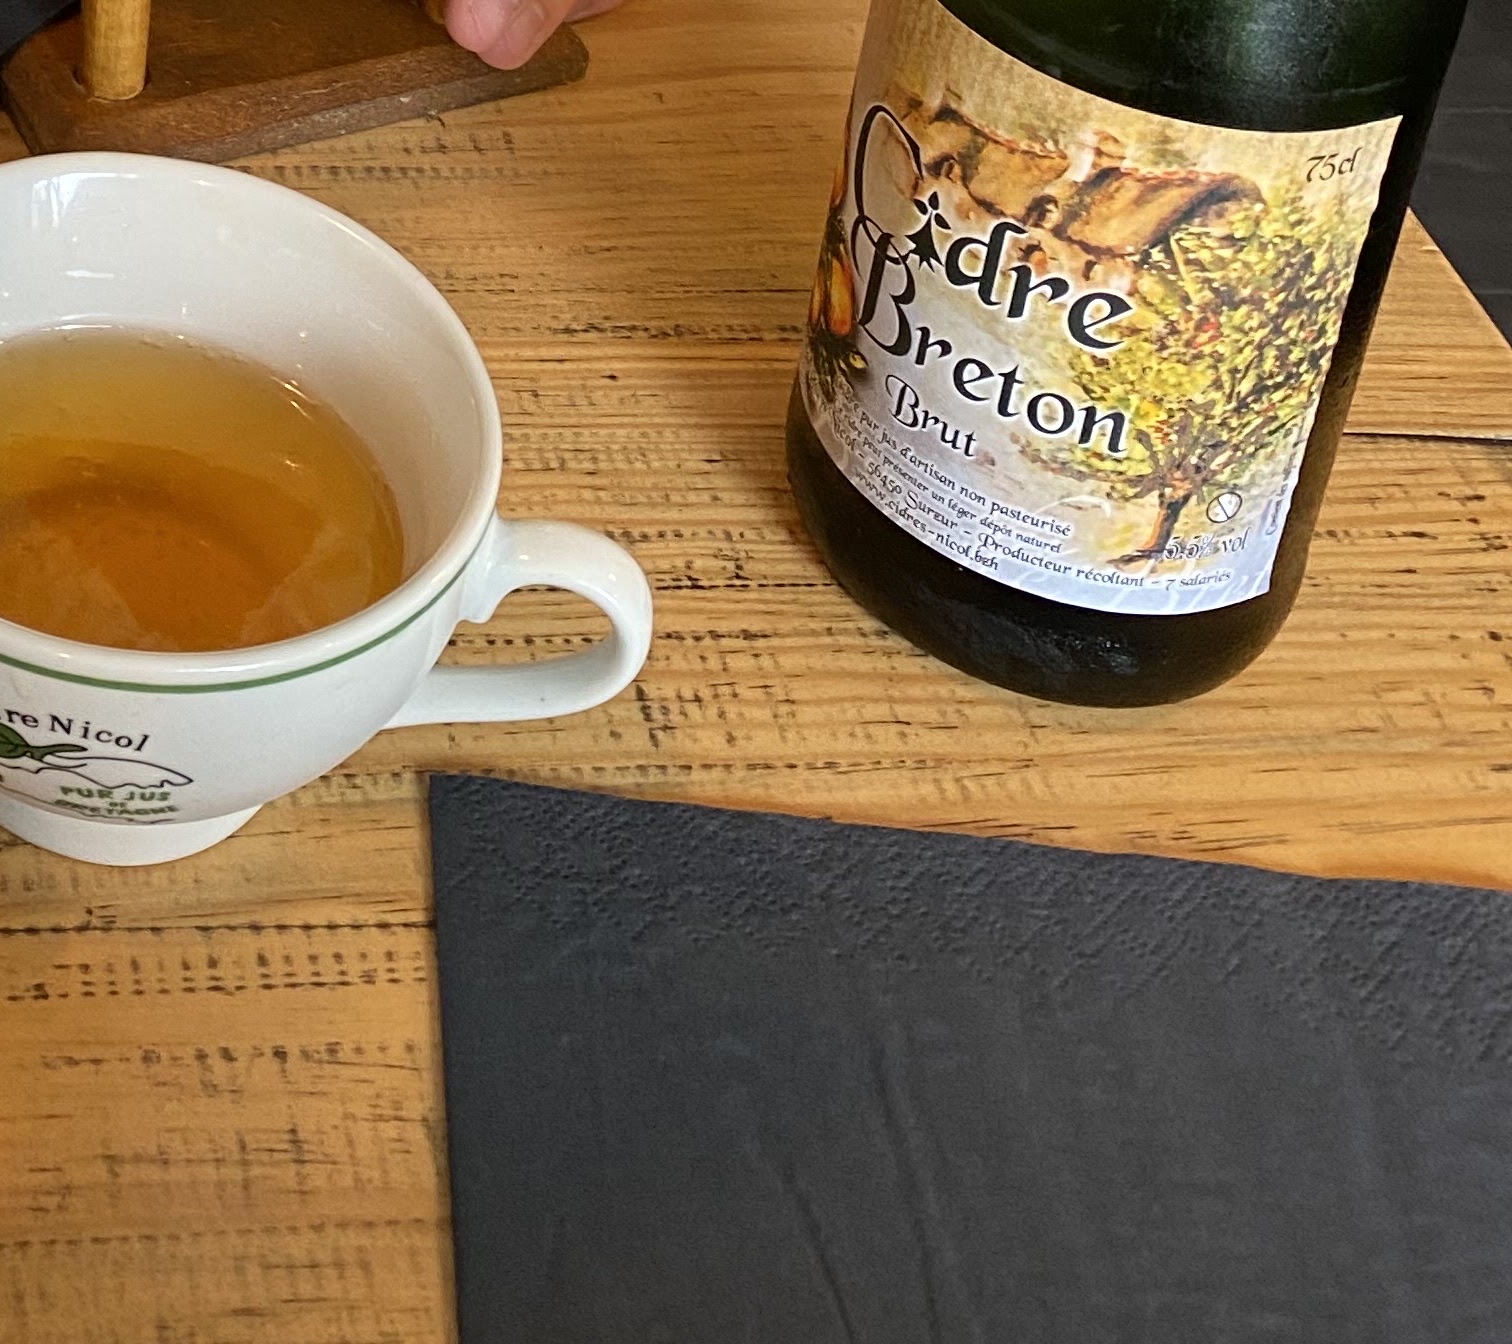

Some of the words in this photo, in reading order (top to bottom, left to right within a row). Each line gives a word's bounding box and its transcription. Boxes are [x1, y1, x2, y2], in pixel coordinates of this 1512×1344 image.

[1305, 150, 1360, 183] 75cl
[851, 214, 1129, 455] Breton
[884, 374, 977, 458] Brut
[859, 410, 880, 431] pur
[877, 427, 897, 450] jus
[959, 486, 986, 506] non
[990, 500, 1072, 537] pasteurisé
[867, 461, 903, 496] 56450
[977, 531, 1072, 574] Producteur
[1076, 563, 1144, 588] récoltant
[1179, 568, 1231, 588] salariés
[931, 491, 945, 505] un
[1015, 529, 1063, 554] naturel
[1163, 534, 1216, 560] 5.5%
[1221, 526, 1252, 554] vol
[49, 713, 151, 753] Nicol
[60, 786, 114, 800] PUR
[122, 791, 171, 802] JUS
